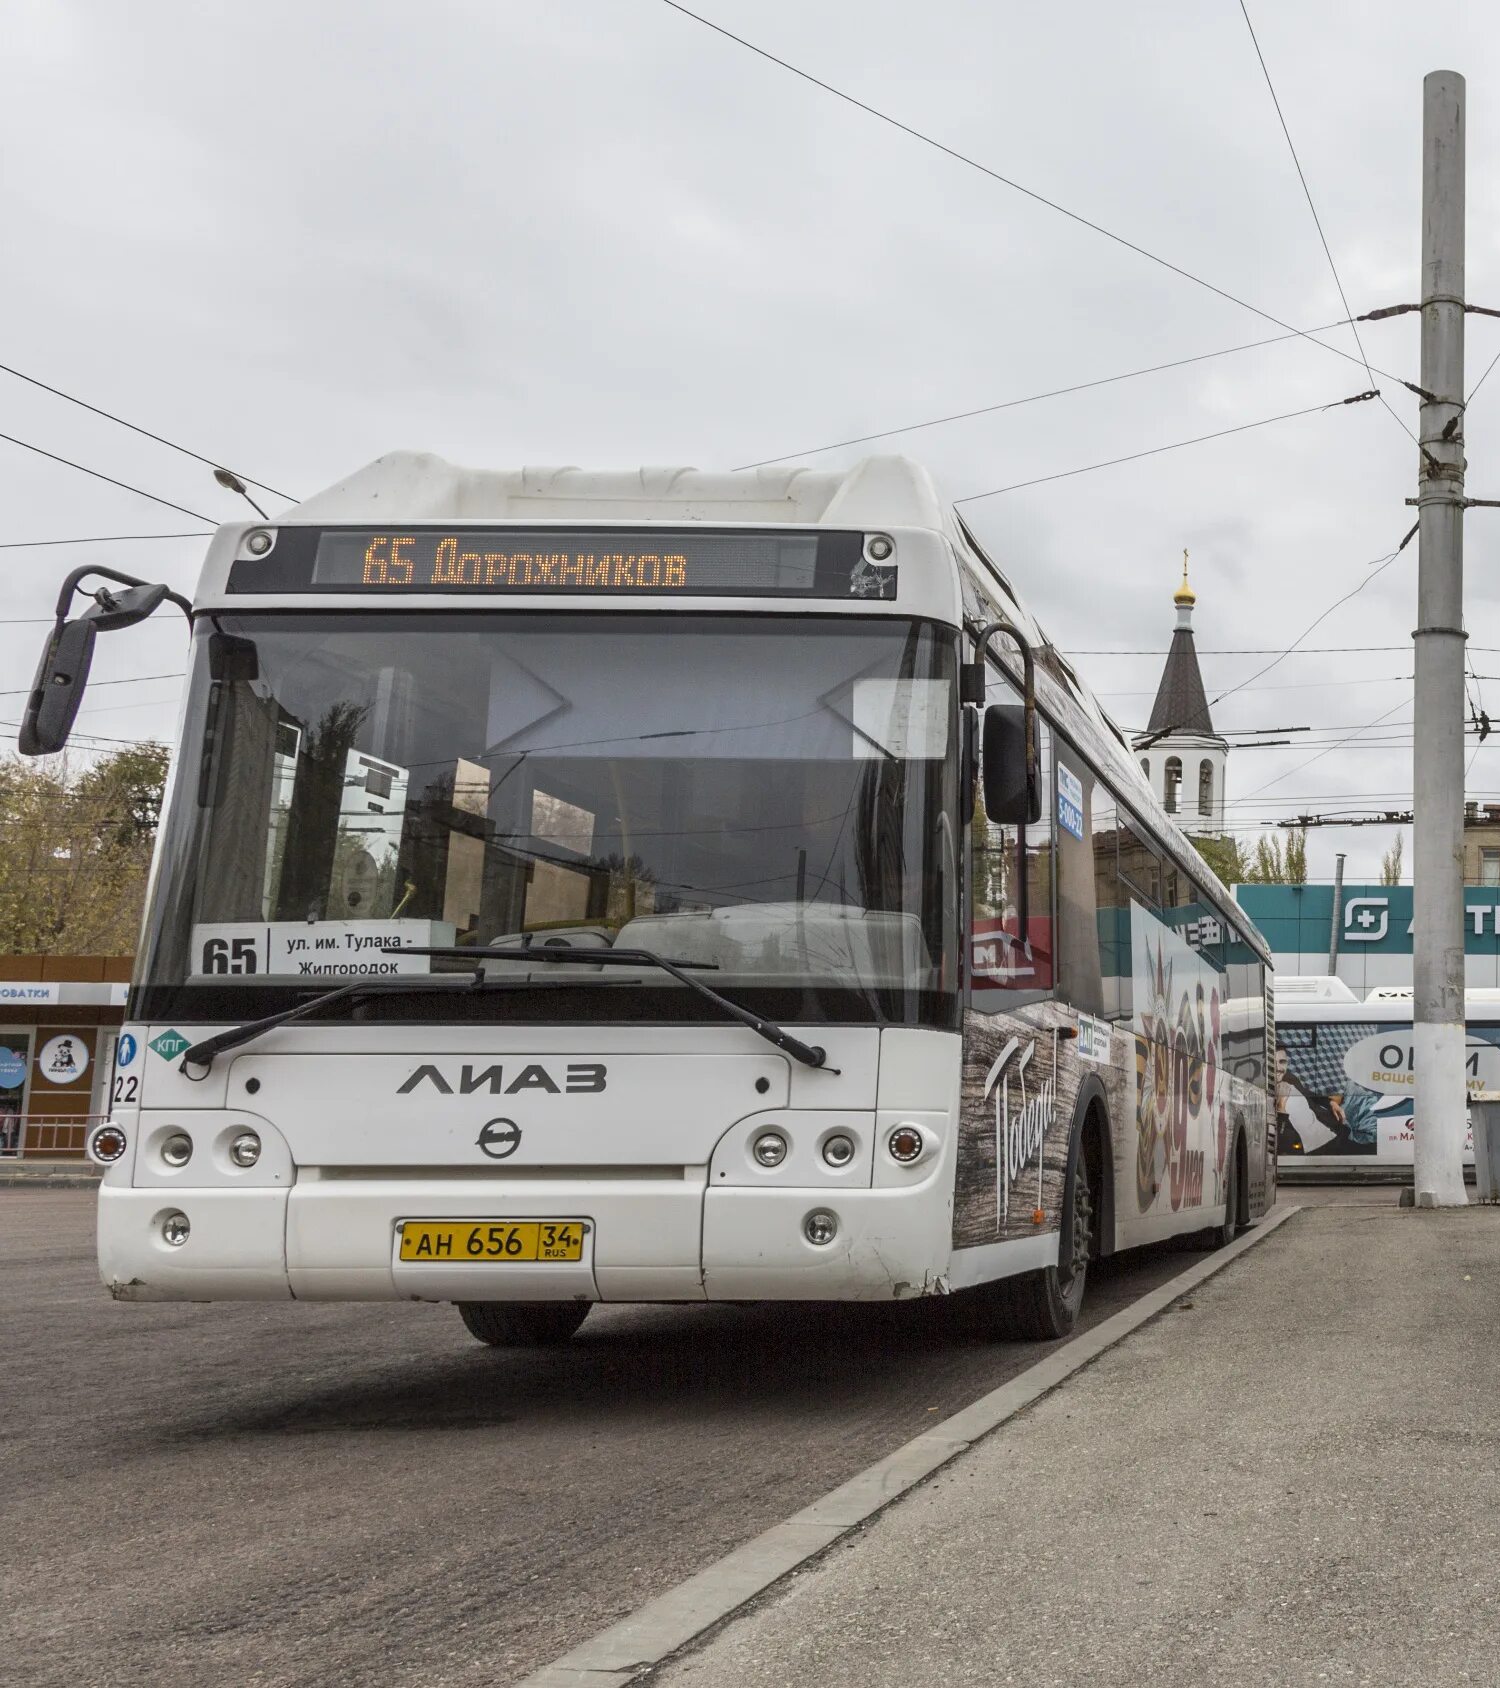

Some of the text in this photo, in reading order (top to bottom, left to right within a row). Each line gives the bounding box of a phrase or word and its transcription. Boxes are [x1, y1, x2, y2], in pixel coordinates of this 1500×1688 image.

[362, 536, 416, 585] 65
[202, 937, 258, 975] 65
[286, 938, 310, 955] ул.
[315, 936, 340, 950] им.
[345, 933, 402, 952] Тулака
[299, 960, 399, 975] Жилгородок
[156, 1038, 184, 1052] КПГ
[114, 1076, 138, 1103] 22
[396, 1063, 608, 1095] ЛИАЗ
[466, 1227, 523, 1256] 656
[542, 1226, 571, 1248] 34
[544, 1249, 566, 1257] RUS
